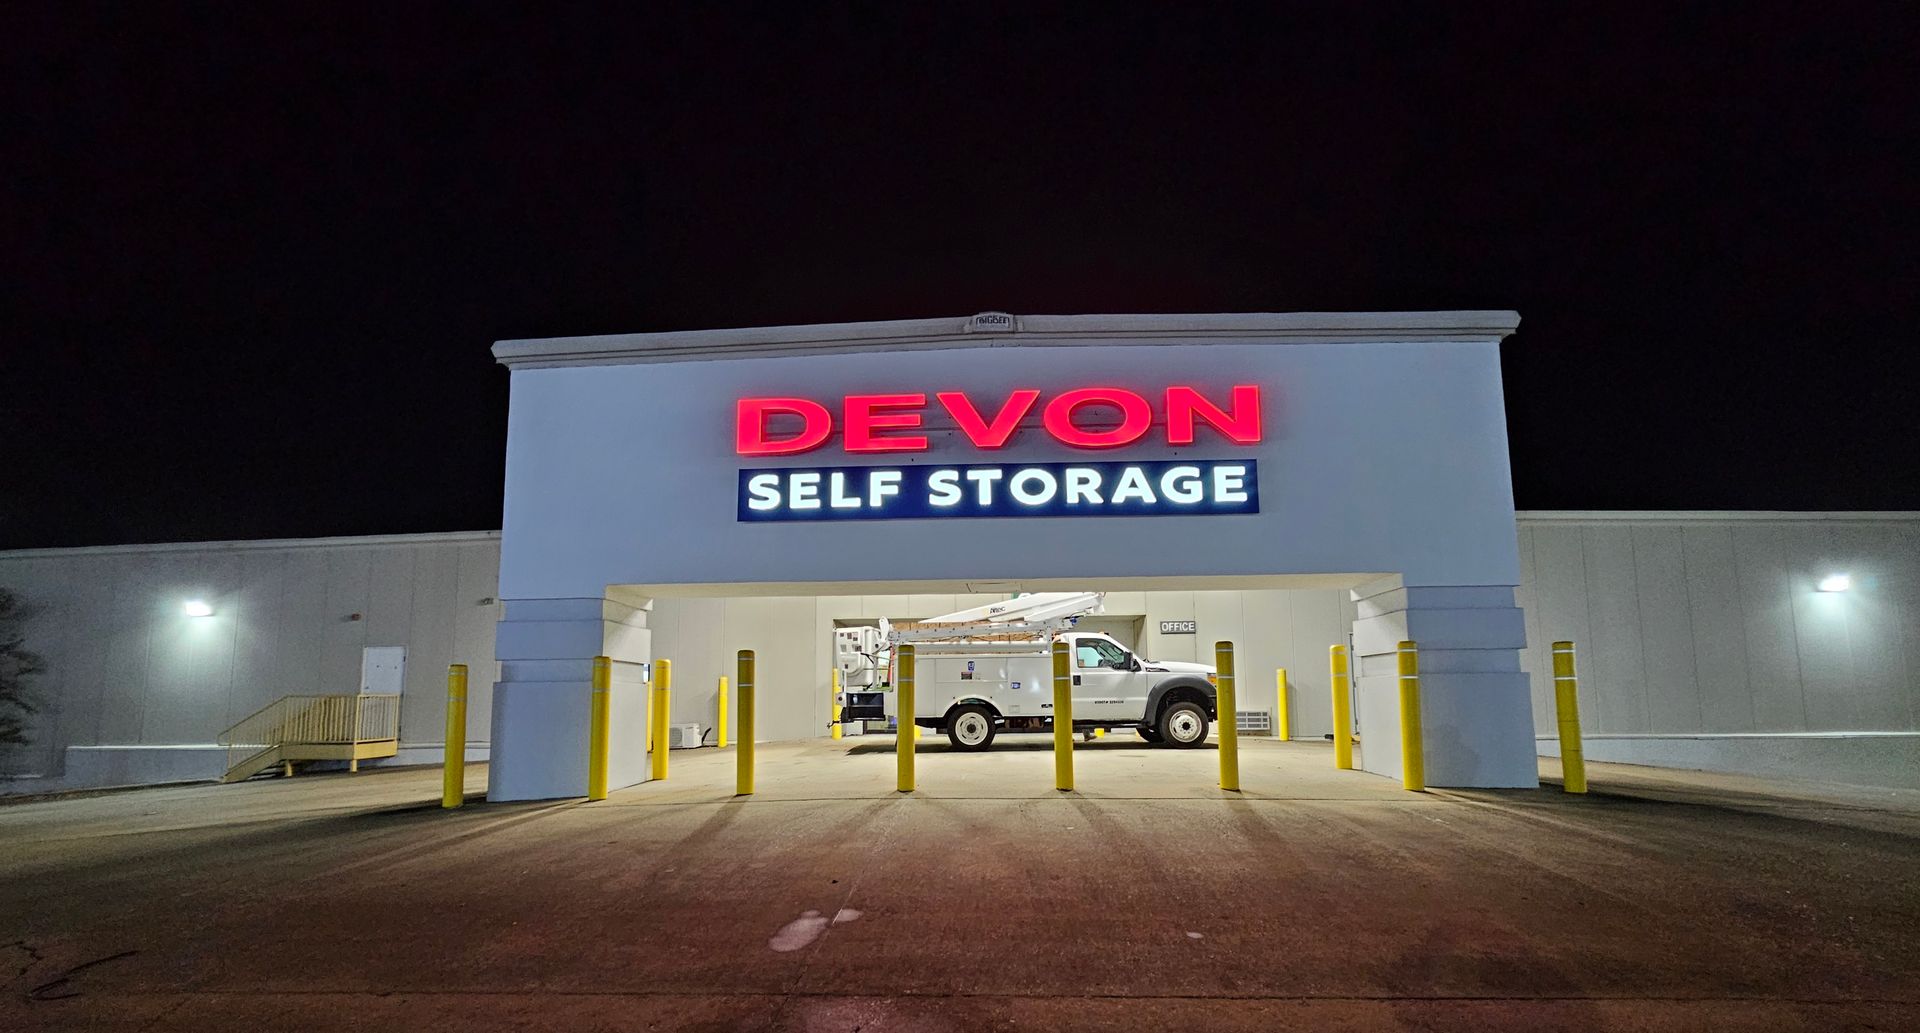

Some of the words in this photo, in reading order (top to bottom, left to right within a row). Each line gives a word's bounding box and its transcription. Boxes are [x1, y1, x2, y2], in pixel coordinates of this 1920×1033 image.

[737, 384, 1261, 455] DEVON
[748, 471, 902, 511] SELF
[928, 465, 1248, 507] STORAGE
[1161, 622, 1195, 631] OFFICE
